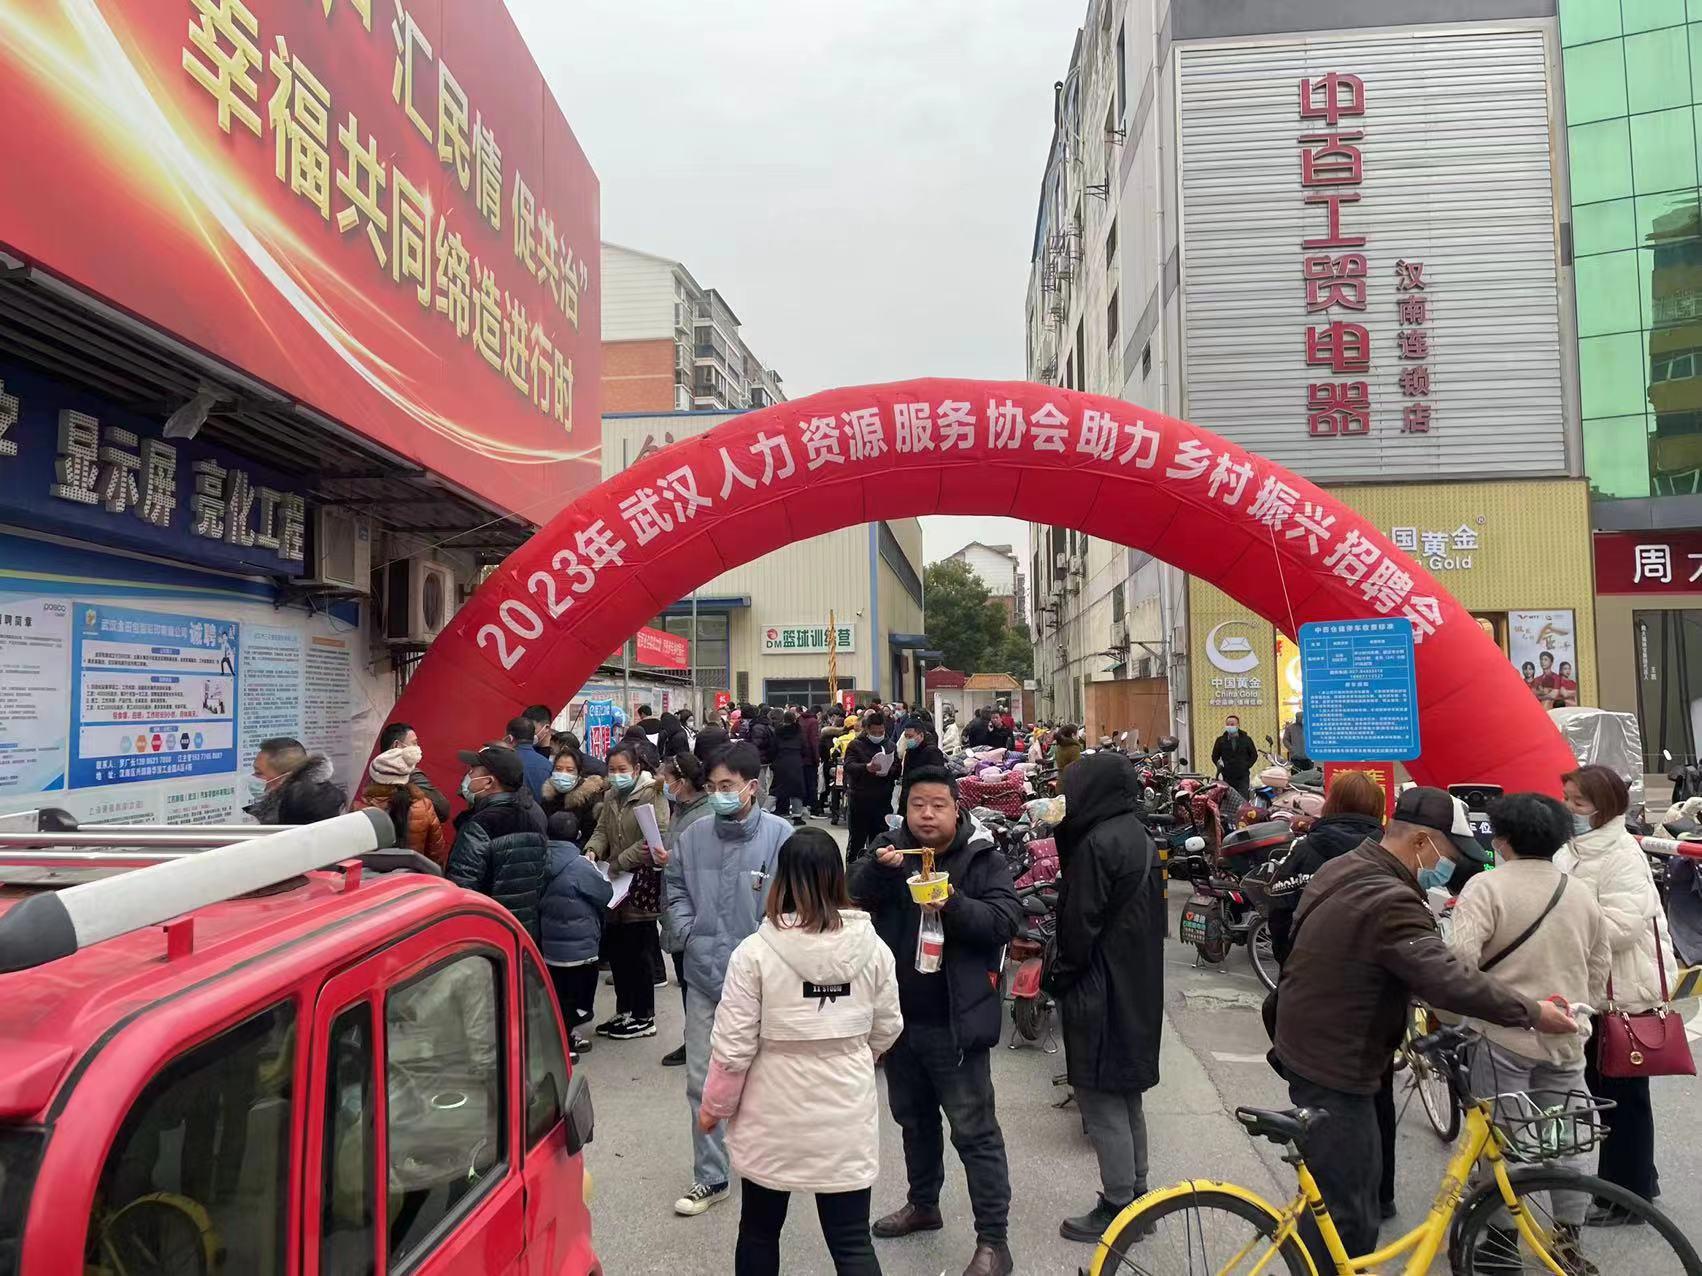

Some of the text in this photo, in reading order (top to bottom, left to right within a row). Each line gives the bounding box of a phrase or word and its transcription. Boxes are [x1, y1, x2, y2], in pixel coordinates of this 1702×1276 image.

[392, 0, 502, 231] 汇民情
[182, 0, 574, 432] 幸福共同缔造进行时
[1297, 71, 1371, 437] 中百工贸电器
[1396, 258, 1432, 434] 汉南连锁店
[50, 408, 177, 527] 显示屏
[191, 458, 304, 561] 亮化工程
[1381, 523, 1479, 557] 国黄金
[1429, 556, 1472, 570] Gold
[0, 614, 32, 627] 聘简章
[1211, 677, 1262, 689] 中国黄金
[1239, 689, 1258, 697] Gold
